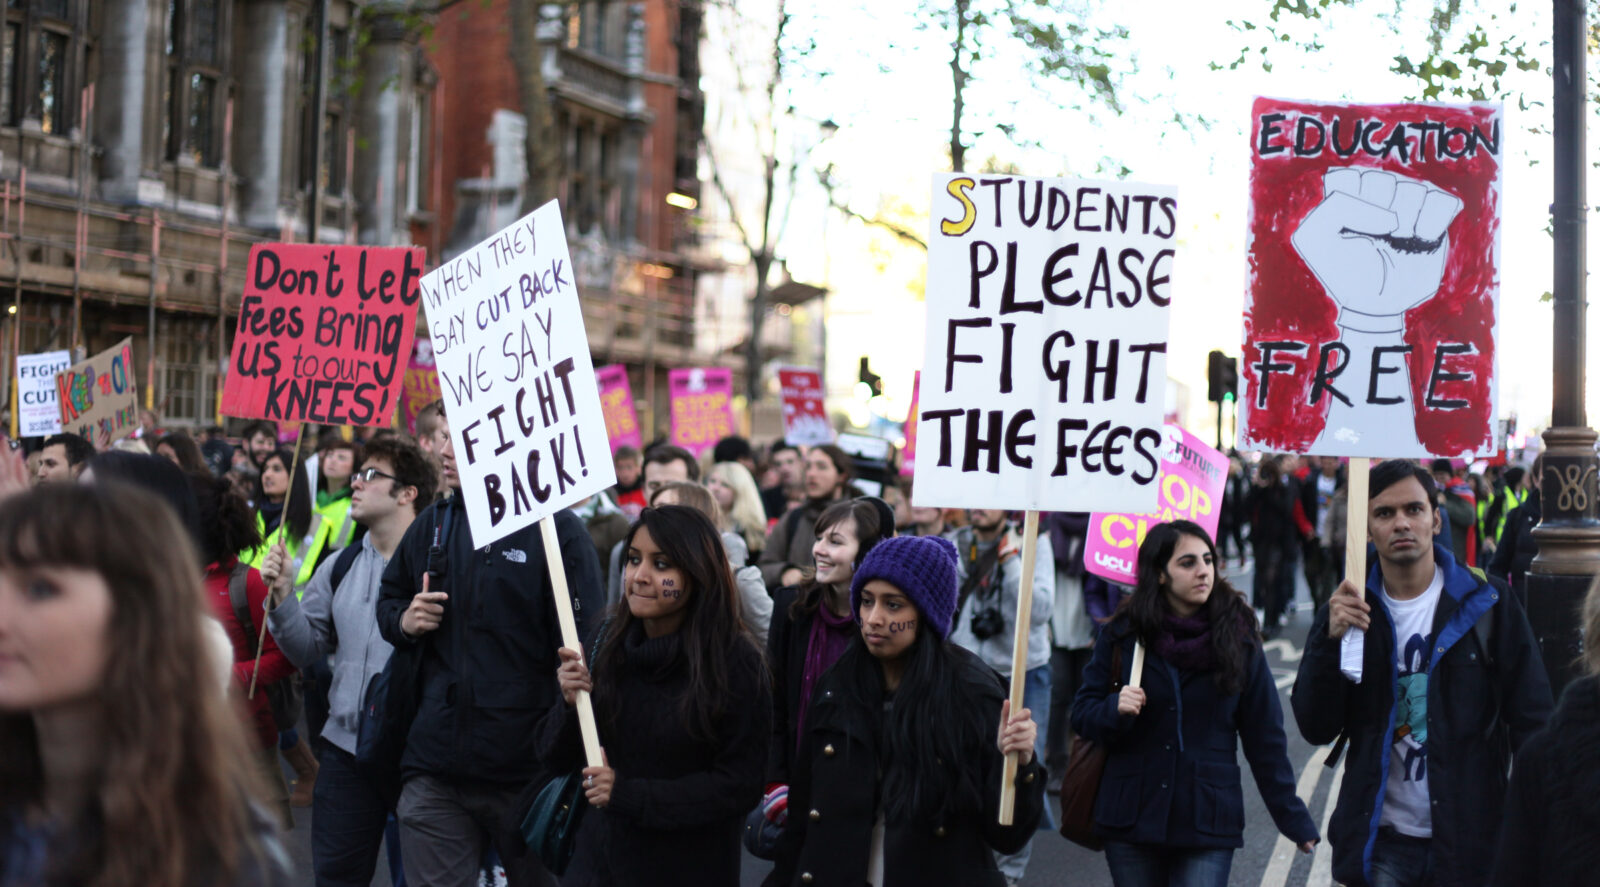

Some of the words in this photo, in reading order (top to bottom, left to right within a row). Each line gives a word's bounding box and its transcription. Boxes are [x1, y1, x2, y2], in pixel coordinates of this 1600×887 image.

[1259, 113, 1499, 163] EDUCATION
[940, 177, 1177, 239] STUDENTS
[254, 250, 343, 298] Don't
[421, 252, 482, 311] WHEN
[488, 217, 536, 270] THEY
[968, 241, 1176, 315] PLEASE
[315, 302, 403, 387] Bring
[433, 309, 465, 355] SAY
[476, 286, 512, 330] CUT
[21, 361, 69, 379] FIGHT
[293, 344, 319, 378] to
[323, 357, 371, 383] our
[442, 346, 493, 407] WE
[502, 307, 553, 382] SAY
[945, 317, 1167, 403] FIGHT
[1254, 341, 1473, 408] FREE
[265, 375, 389, 424] KNEES!
[461, 357, 576, 465] FIGHT
[484, 424, 588, 527] BACK!
[921, 408, 1036, 474] THE
[1051, 418, 1162, 485] FEES
[1175, 442, 1221, 483] FUTURE
